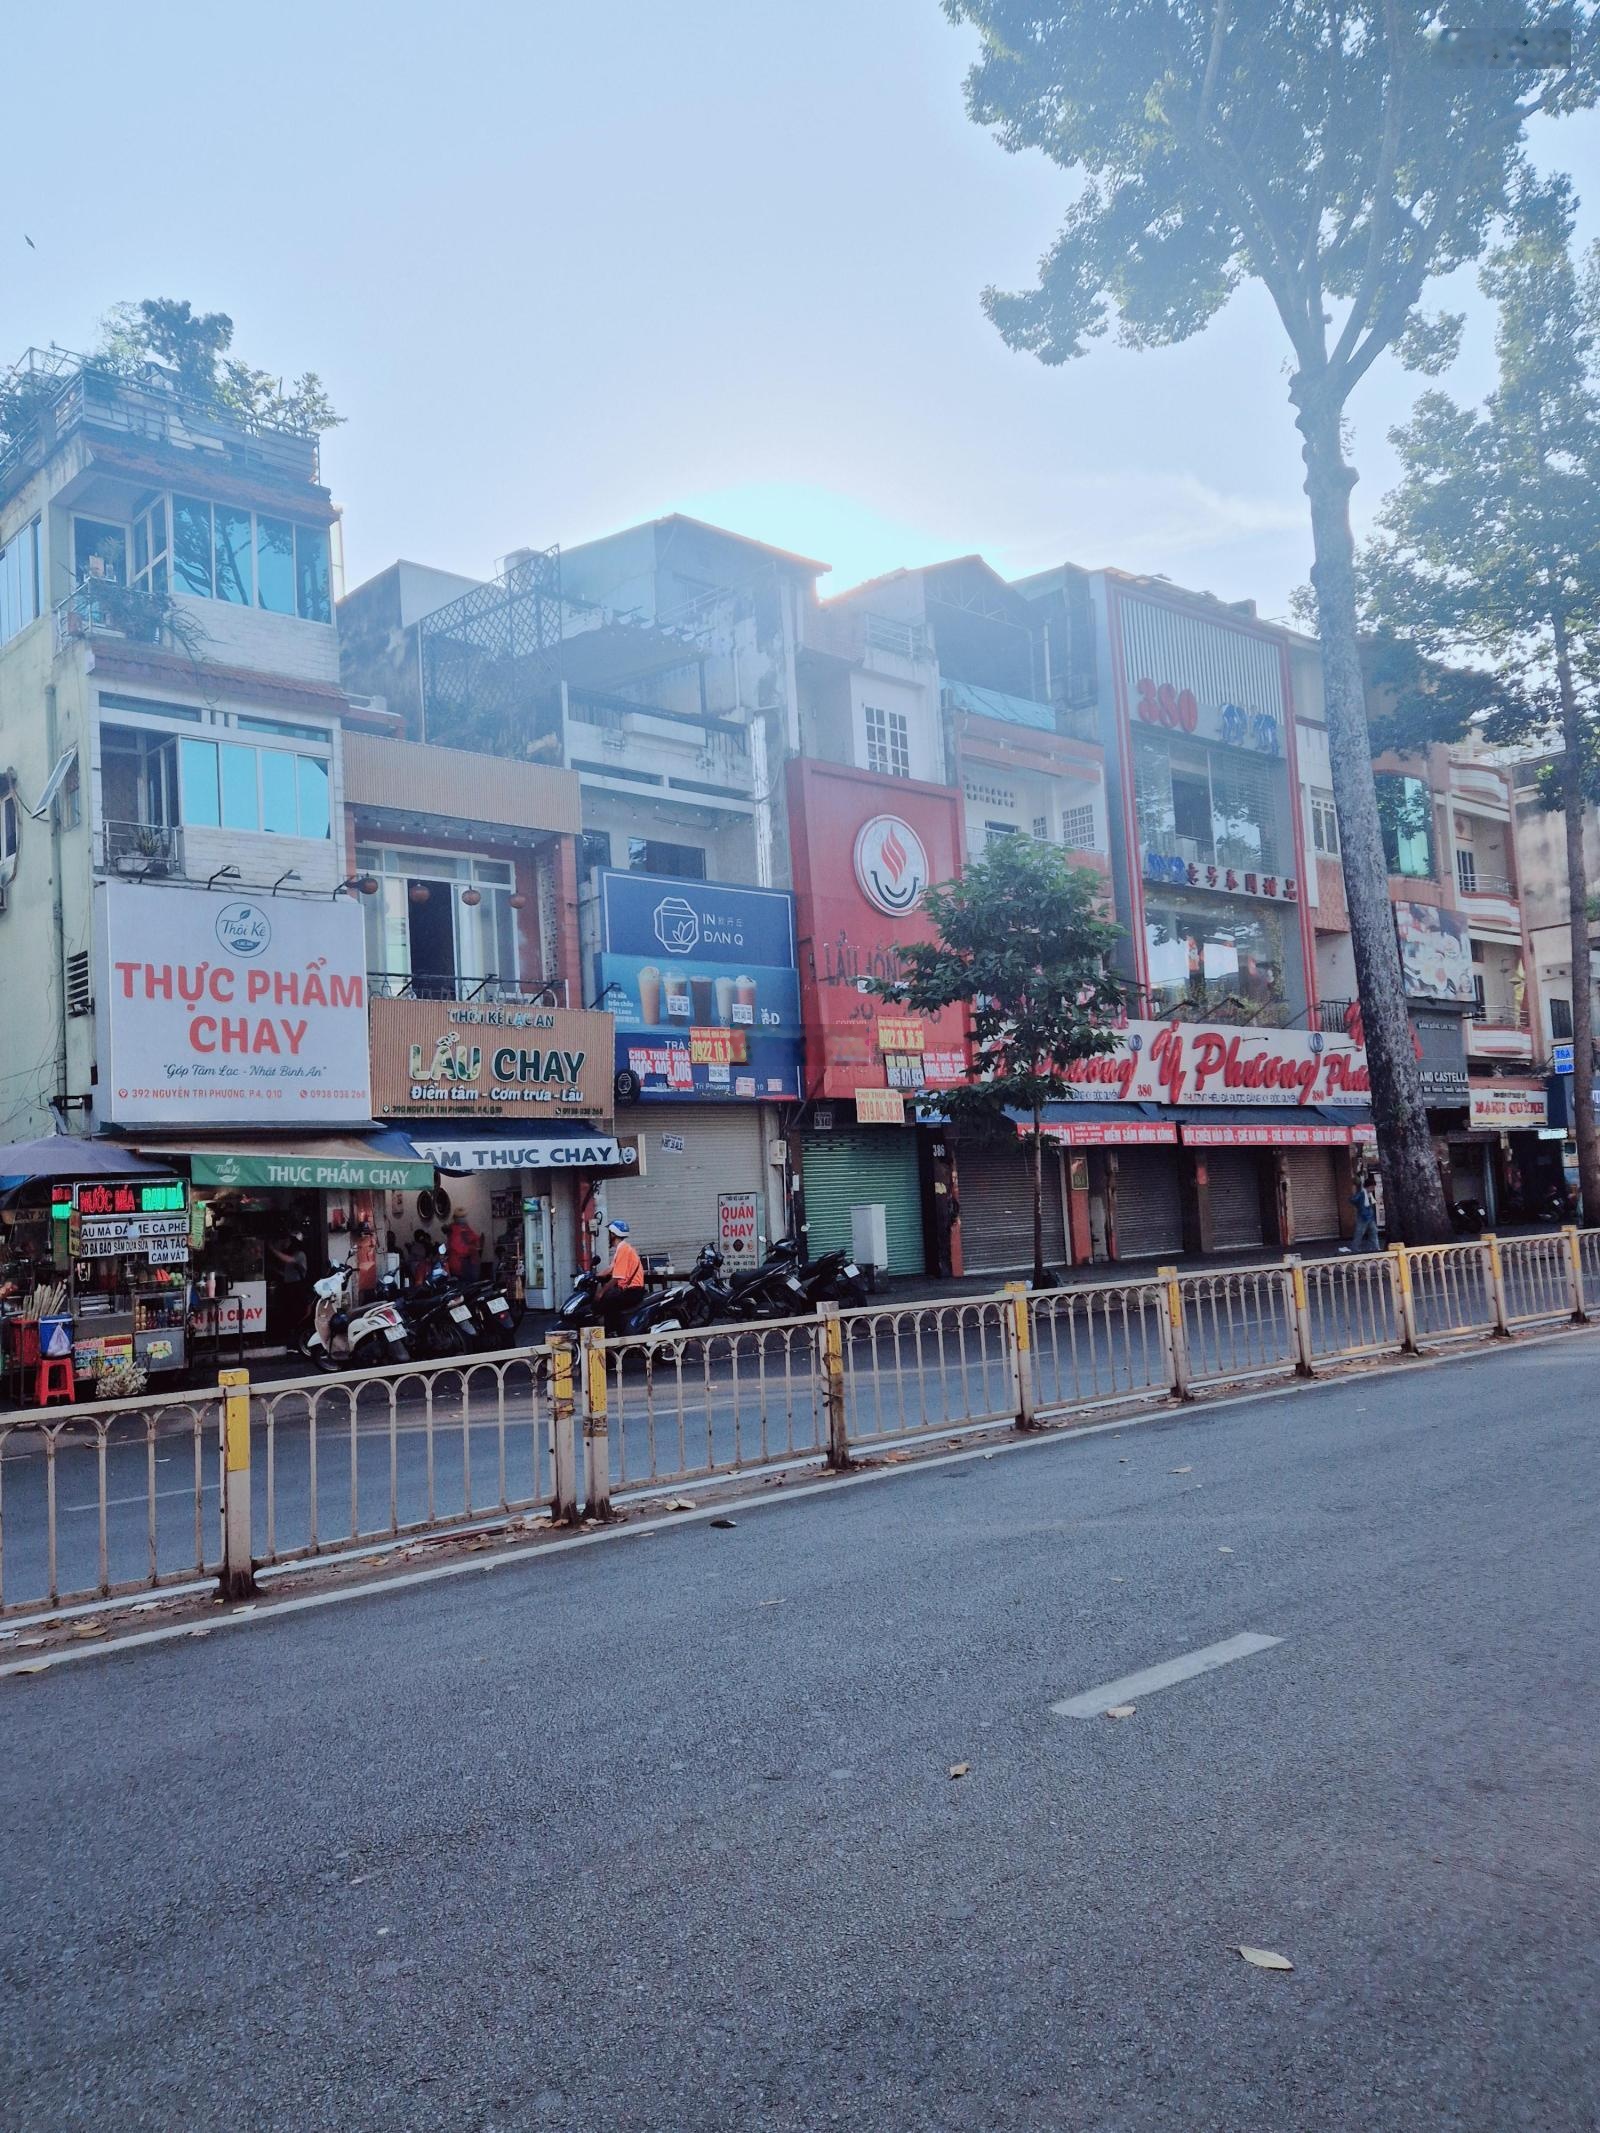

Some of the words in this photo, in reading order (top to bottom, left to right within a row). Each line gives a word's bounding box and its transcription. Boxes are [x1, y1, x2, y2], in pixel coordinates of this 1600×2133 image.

[703, 913, 715, 925] IN
[115, 961, 235, 1011] THỰC
[248, 957, 363, 1008] PHẨM
[536, 1014, 555, 1028] AN
[189, 1015, 308, 1054] CHAY
[409, 1032, 481, 1082] LẨU
[492, 1048, 586, 1084] CHAY
[629, 1050, 647, 1060] CHO
[1192, 1032, 1320, 1105] Phương
[132, 1089, 149, 1098] 392
[411, 1083, 448, 1101] Điểm
[451, 1086, 479, 1101] tâm
[490, 1086, 522, 1101] Cơm
[1137, 1083, 1152, 1097] 380
[473, 1148, 539, 1168] THỰC
[550, 1146, 612, 1163] CHAY
[268, 1165, 312, 1185] THỰC
[317, 1162, 364, 1184] PHẨM
[369, 1169, 409, 1185] CHAY
[722, 1223, 754, 1238] CHAY
[151, 1252, 169, 1263] CAM
